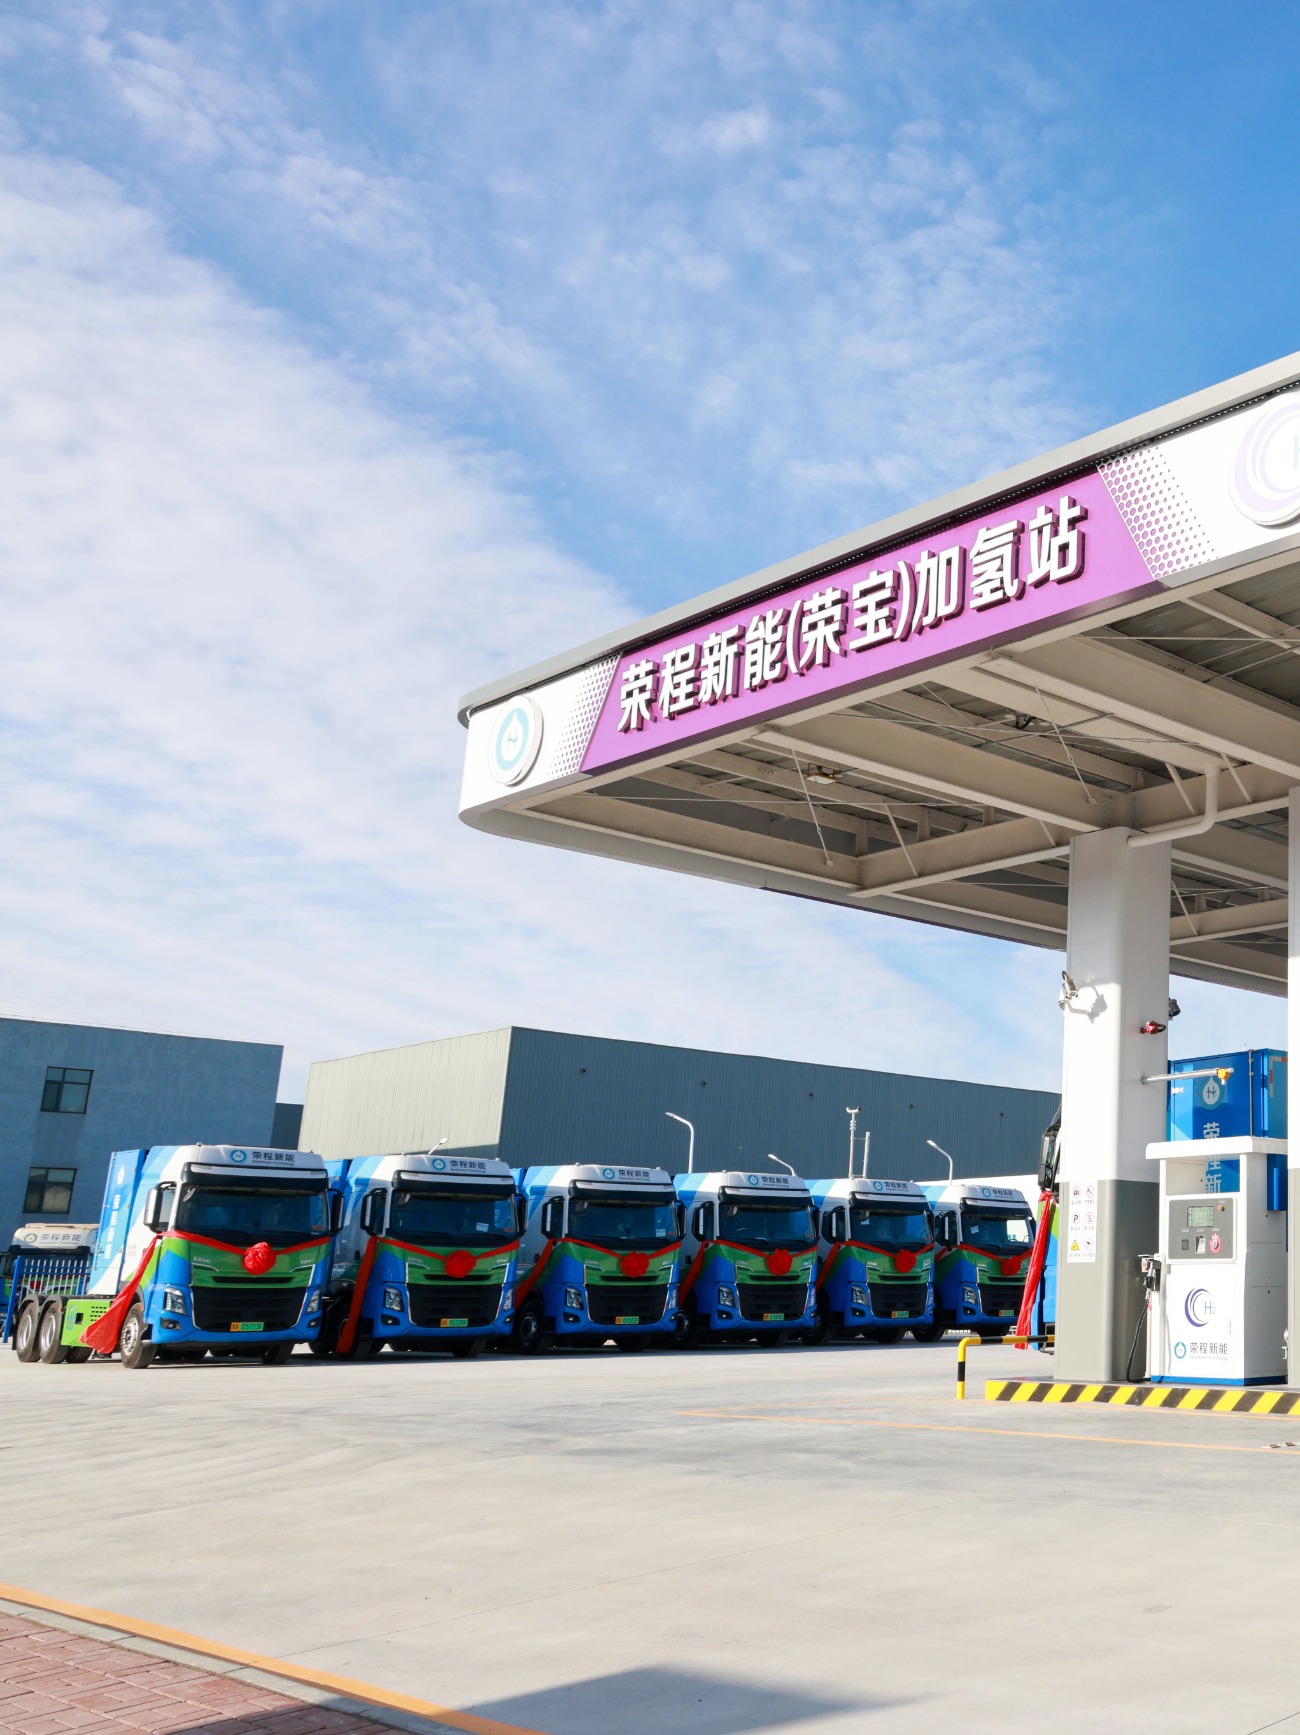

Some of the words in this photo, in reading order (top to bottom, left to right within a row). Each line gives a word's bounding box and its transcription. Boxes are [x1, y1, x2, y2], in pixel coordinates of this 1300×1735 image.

[617, 495, 1086, 734] 荣程新能(荣宝)加氢站
[252, 1151, 295, 1163] 荣程新能
[450, 1160, 486, 1169] 荣程新能
[1189, 1342, 1228, 1355] 荣程新能
